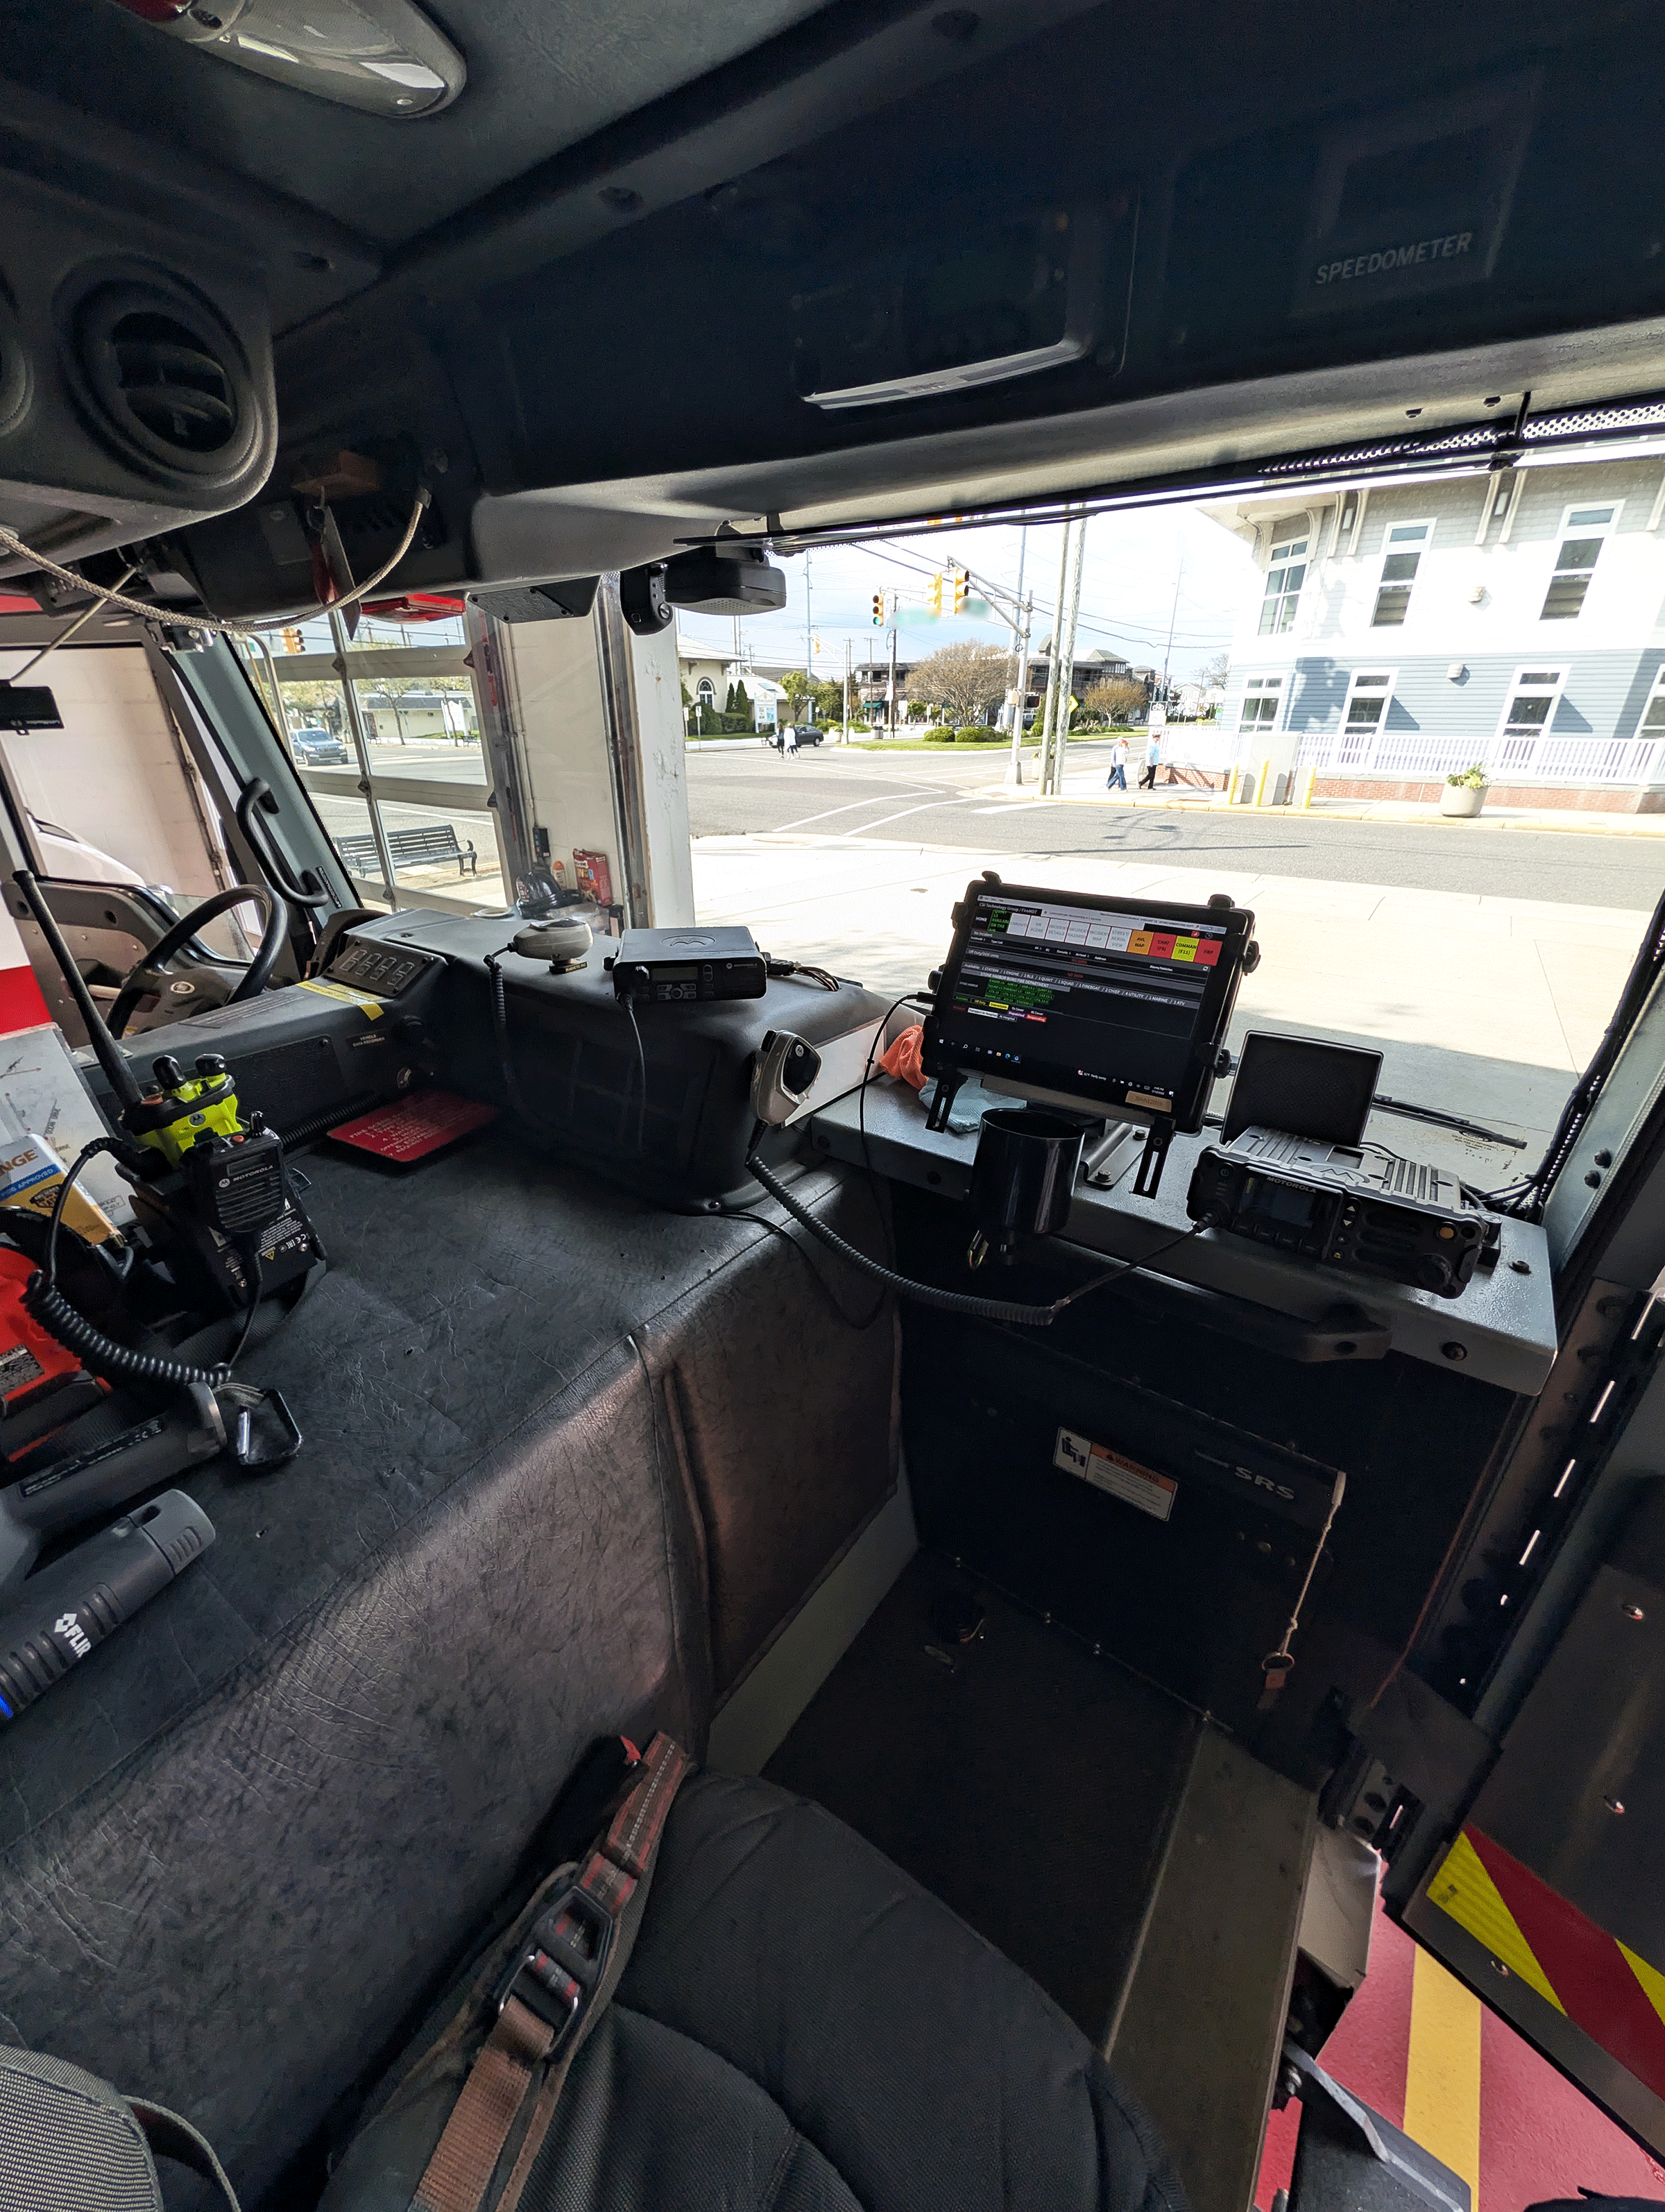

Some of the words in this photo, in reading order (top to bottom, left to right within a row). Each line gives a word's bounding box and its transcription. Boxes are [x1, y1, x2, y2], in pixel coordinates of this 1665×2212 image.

[1316, 232, 1472, 284] SPEEDOMETER
[985, 903, 1007, 911] Technology
[1024, 979, 1049, 987] DEPARTMENT
[18, 1168, 54, 1189] APPROVED
[233, 1165, 273, 1182] MOTOROLA
[1266, 1176, 1317, 1193] MOTOROLA
[1116, 1456, 1161, 1483] WARNING
[1234, 1466, 1295, 1501] SRS
[65, 1625, 92, 1658] FLIR
